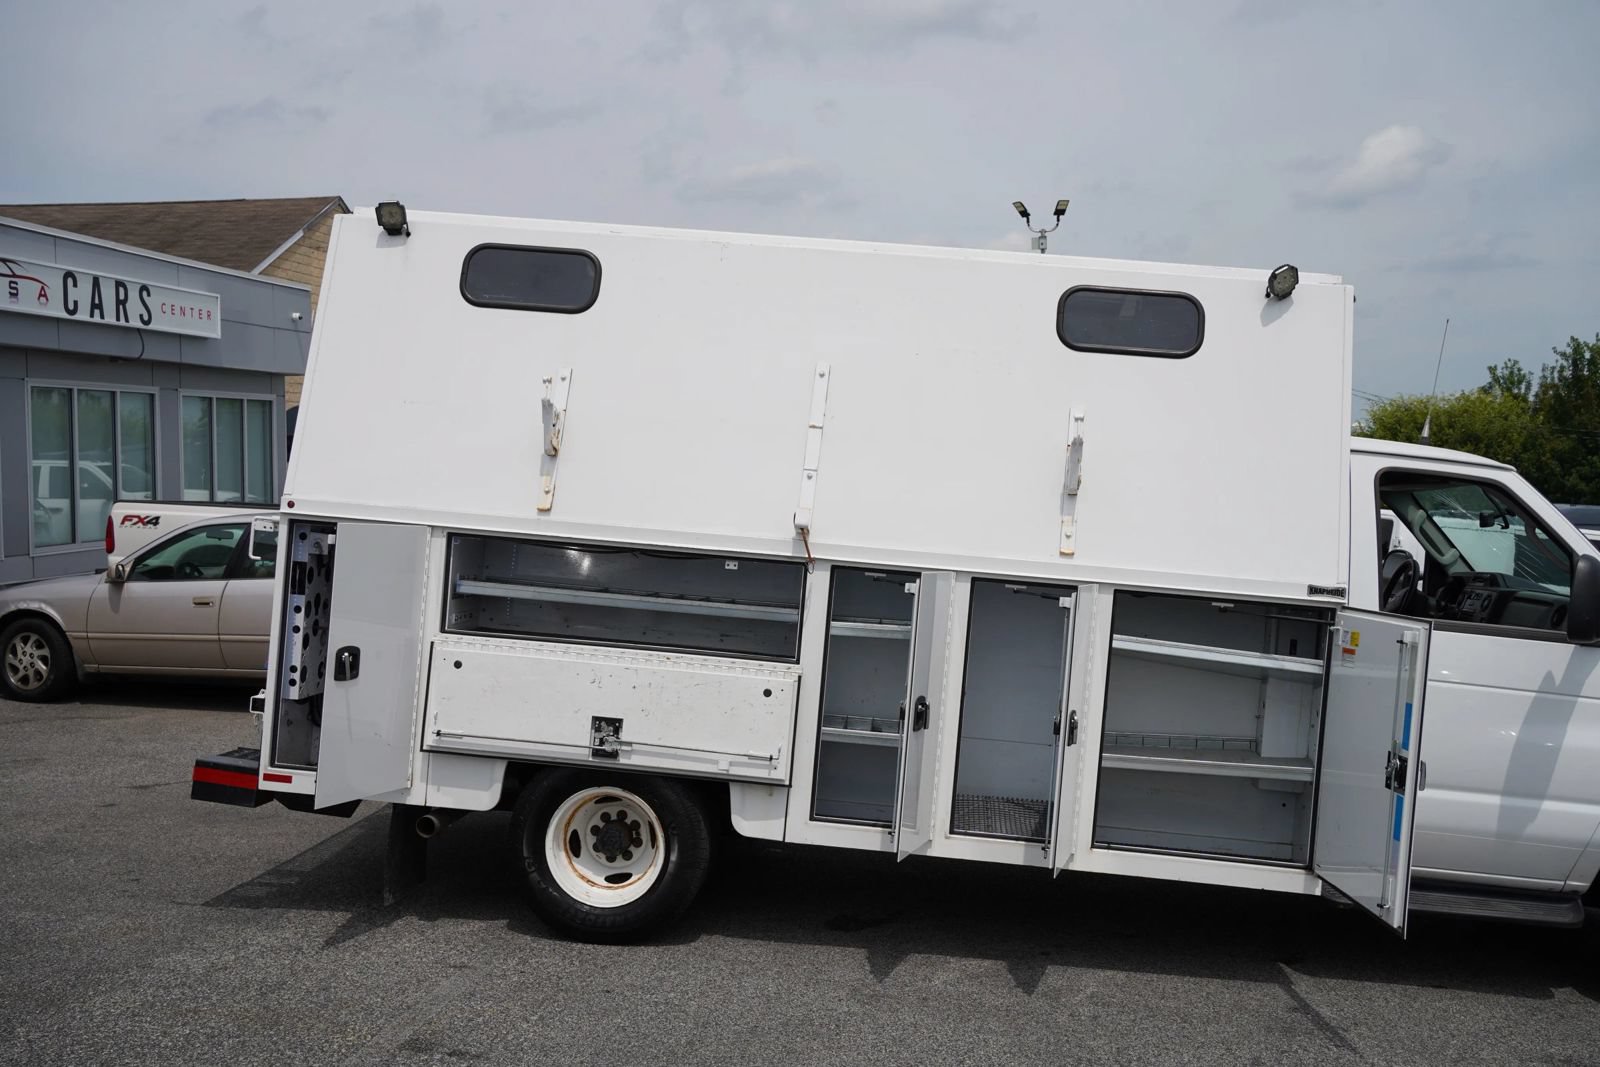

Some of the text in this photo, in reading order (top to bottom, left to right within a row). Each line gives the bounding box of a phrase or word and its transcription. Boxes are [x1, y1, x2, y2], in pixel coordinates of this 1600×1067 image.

[63, 271, 152, 326] CARS
[161, 303, 212, 320] CENTER
[120, 515, 160, 526] FX4
